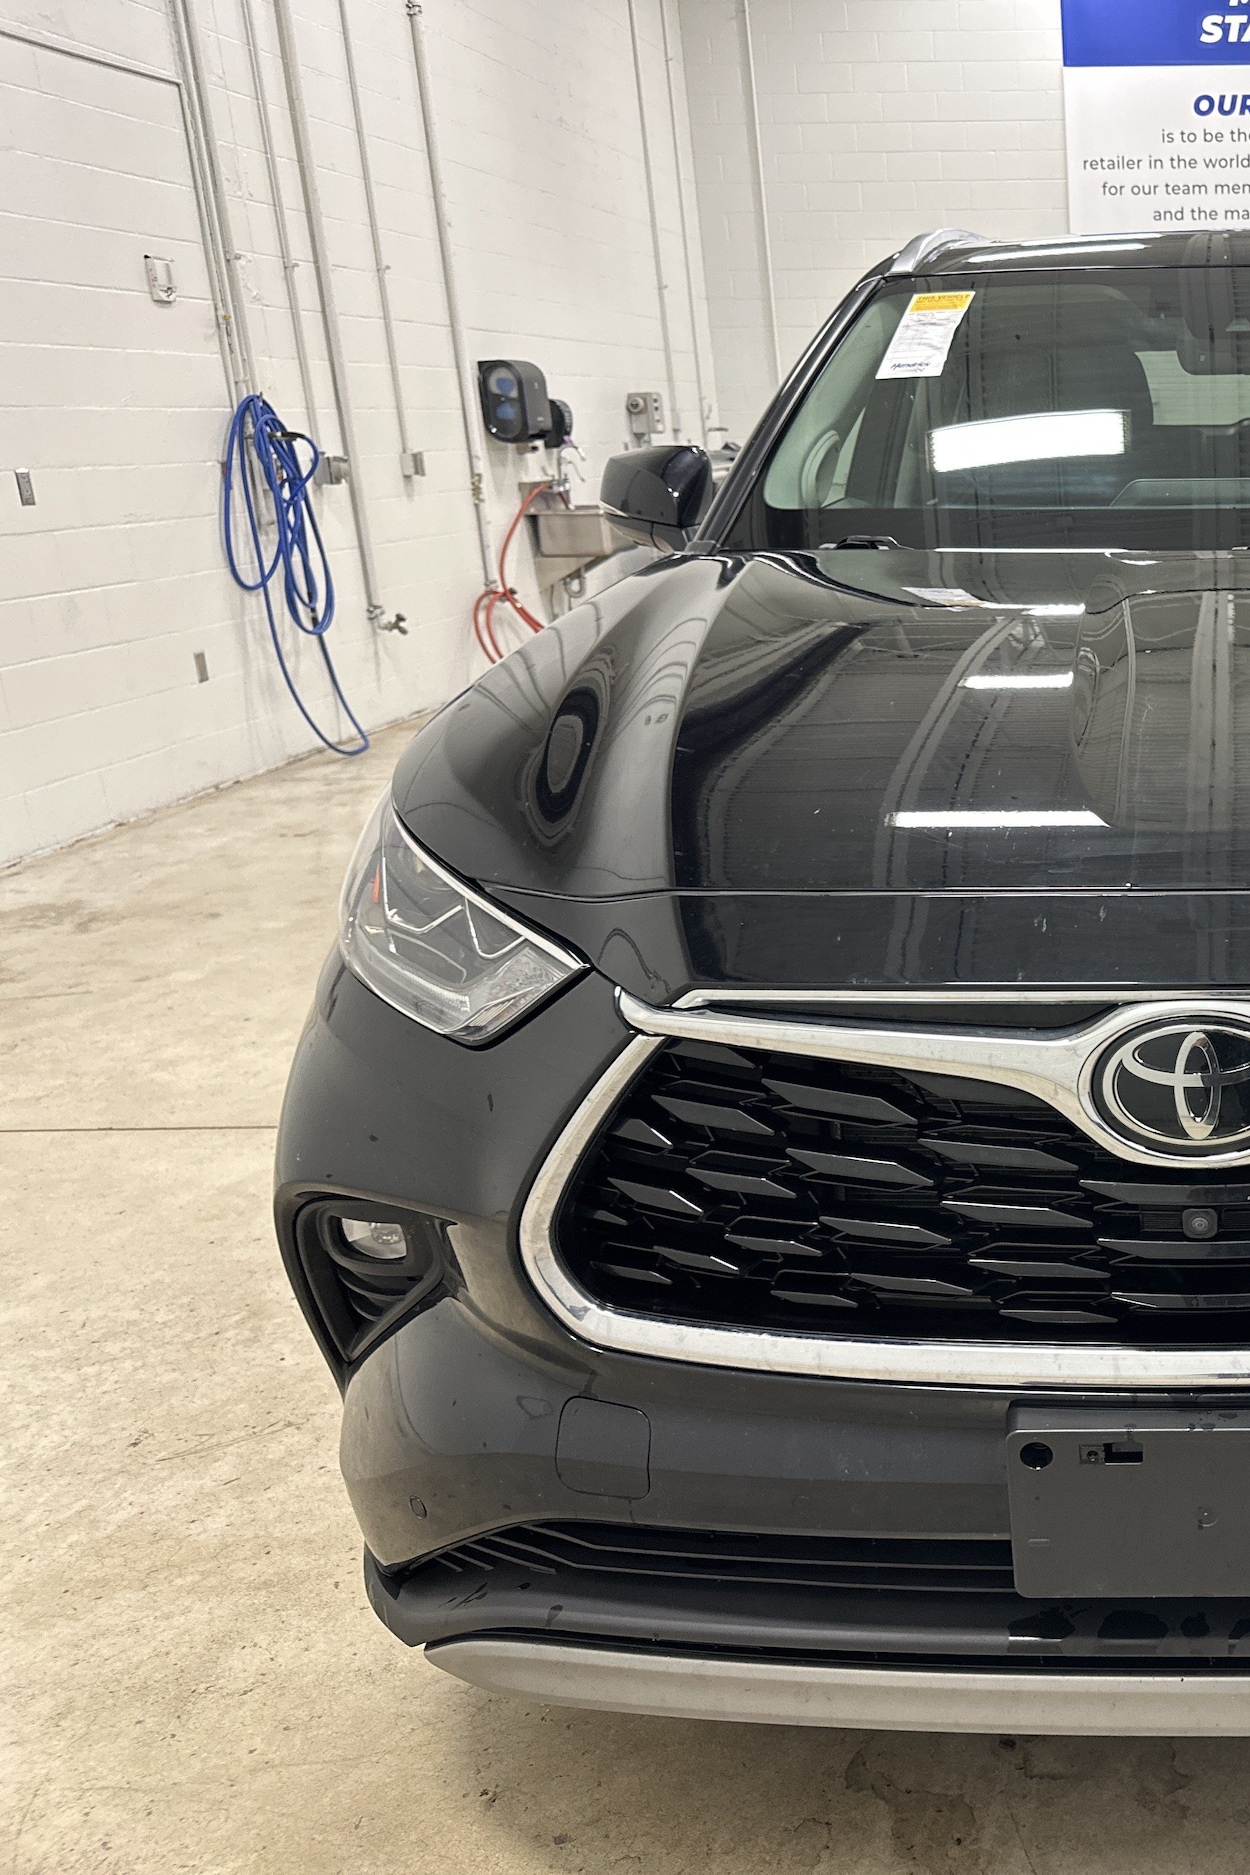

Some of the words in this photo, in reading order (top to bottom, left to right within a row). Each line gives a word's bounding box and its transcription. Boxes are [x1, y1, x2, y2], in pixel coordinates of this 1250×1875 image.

[1161, 128, 1175, 144] is
[1179, 130, 1197, 144] to
[1203, 128, 1224, 143] be
[1083, 155, 1143, 171] retailer
[1148, 154, 1164, 170] in
[1169, 154, 1198, 170] the
[1101, 181, 1126, 196] for
[1130, 184, 1159, 196] our
[1164, 182, 1208, 196] team
[1152, 206, 1185, 222] and
[1190, 206, 1219, 221] the
